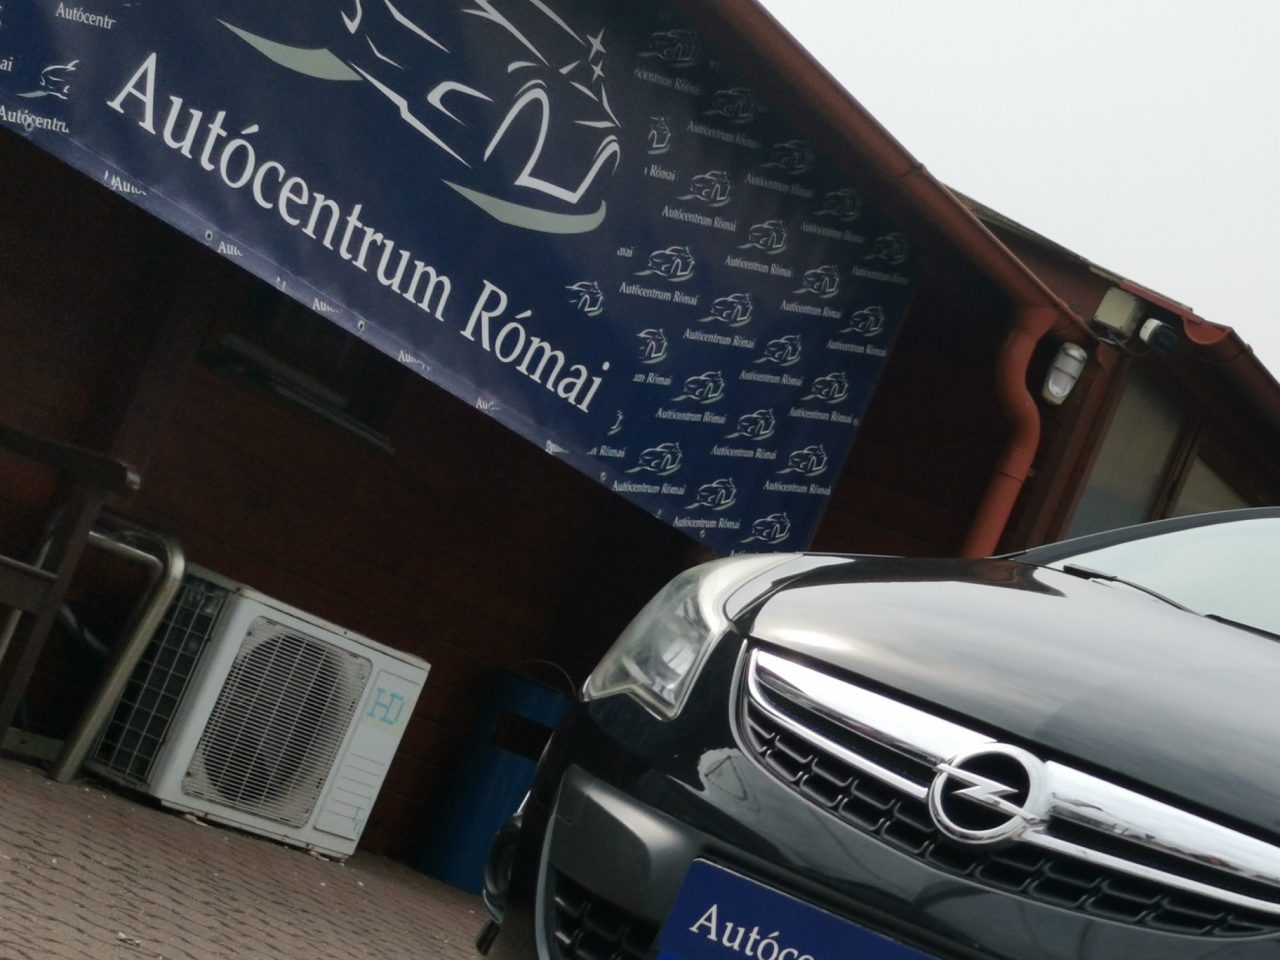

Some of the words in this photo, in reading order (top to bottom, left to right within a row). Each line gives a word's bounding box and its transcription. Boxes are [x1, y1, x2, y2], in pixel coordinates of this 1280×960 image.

[661, 205, 712, 227] Autócentrum
[713, 216, 737, 232] Római
[107, 52, 452, 321] Autócentrum
[460, 279, 611, 413] Római
[724, 255, 769, 273] Autócentrum
[770, 262, 792, 278] Római
[619, 281, 672, 301] Autócentrum
[673, 290, 699, 306] Római
[682, 327, 732, 346] Autócentrum
[732, 335, 756, 349] Római
[655, 407, 702, 422] Autócentrum
[702, 411, 728, 425] Római
[788, 406, 830, 420] Autócentrum
[710, 444, 754, 458] Autócentrum
[755, 447, 778, 460] Római
[612, 480, 661, 494] Autócentrum
[661, 482, 687, 496] Római
[763, 480, 807, 494] Autócentrum
[808, 481, 831, 496] Római
[673, 516, 717, 529] Autócentrum
[718, 517, 741, 530] Római
